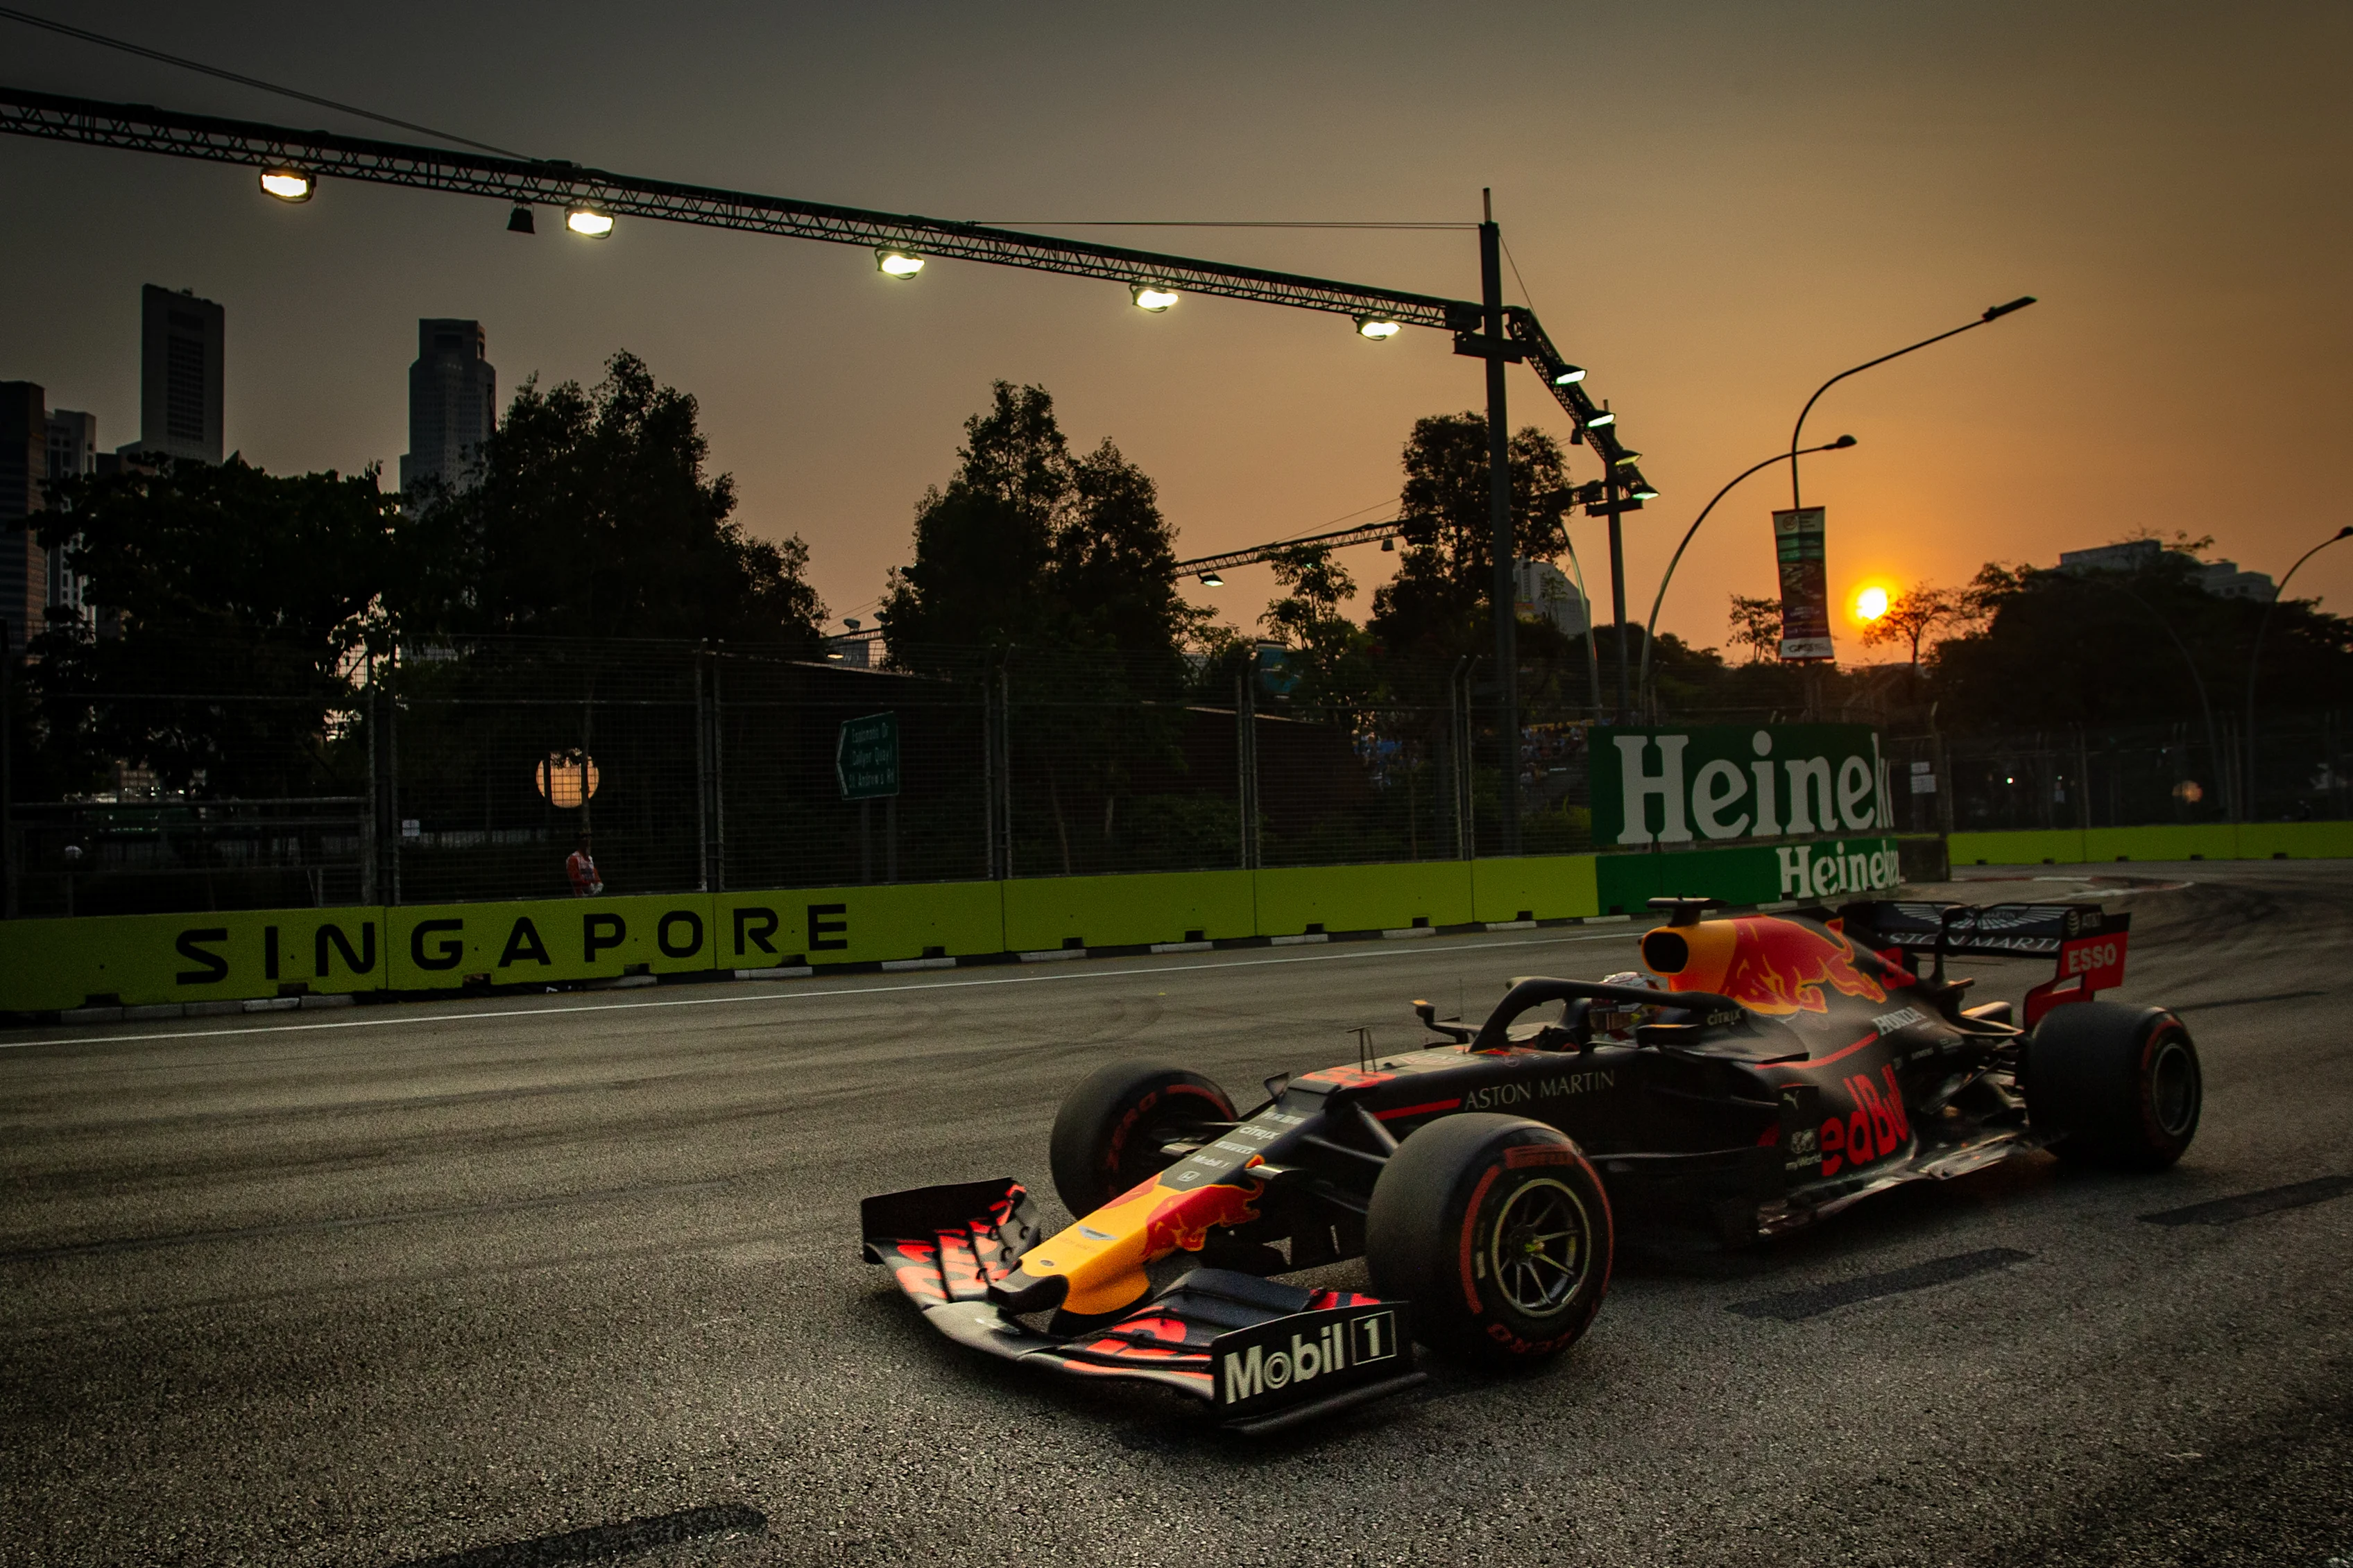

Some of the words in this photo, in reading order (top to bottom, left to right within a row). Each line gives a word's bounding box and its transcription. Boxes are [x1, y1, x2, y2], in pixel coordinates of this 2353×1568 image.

[176, 903, 847, 985] SINGAPORE
[2068, 942, 2117, 973] ESSO
[1872, 1006, 1928, 1037] HONDA
[1465, 1083, 1532, 1111] ASTON
[1539, 1069, 1616, 1098] MARTIN
[1223, 1321, 1345, 1405] Mobil
